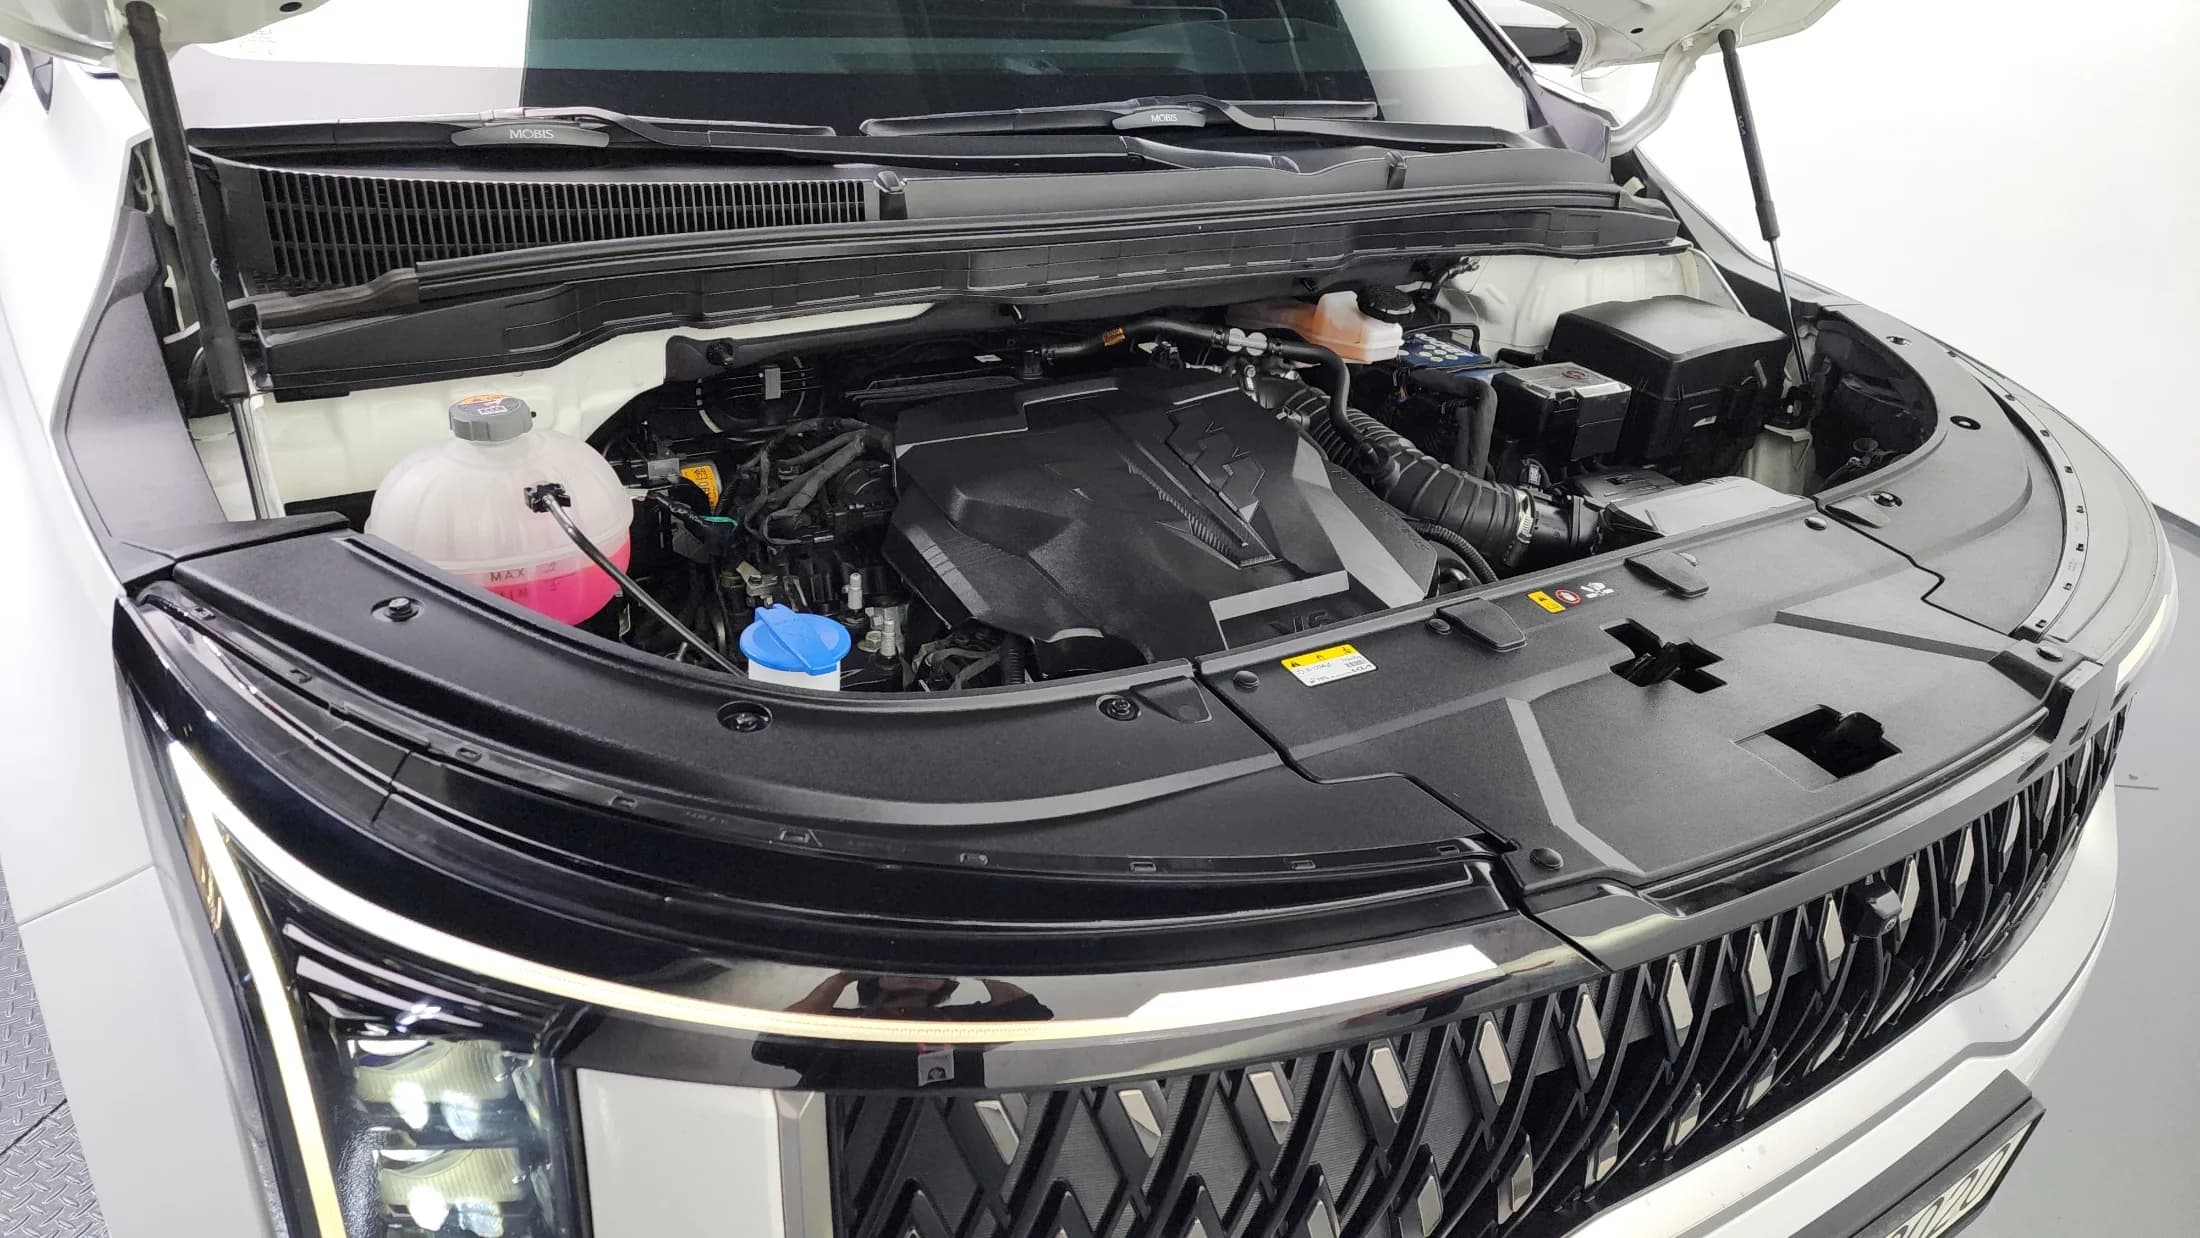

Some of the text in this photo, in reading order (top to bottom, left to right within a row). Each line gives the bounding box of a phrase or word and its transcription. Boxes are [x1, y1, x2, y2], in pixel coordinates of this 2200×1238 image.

[1151, 113, 1177, 123] MOBIS
[509, 128, 554, 139] MOBIS
[490, 568, 525, 582] MAX
